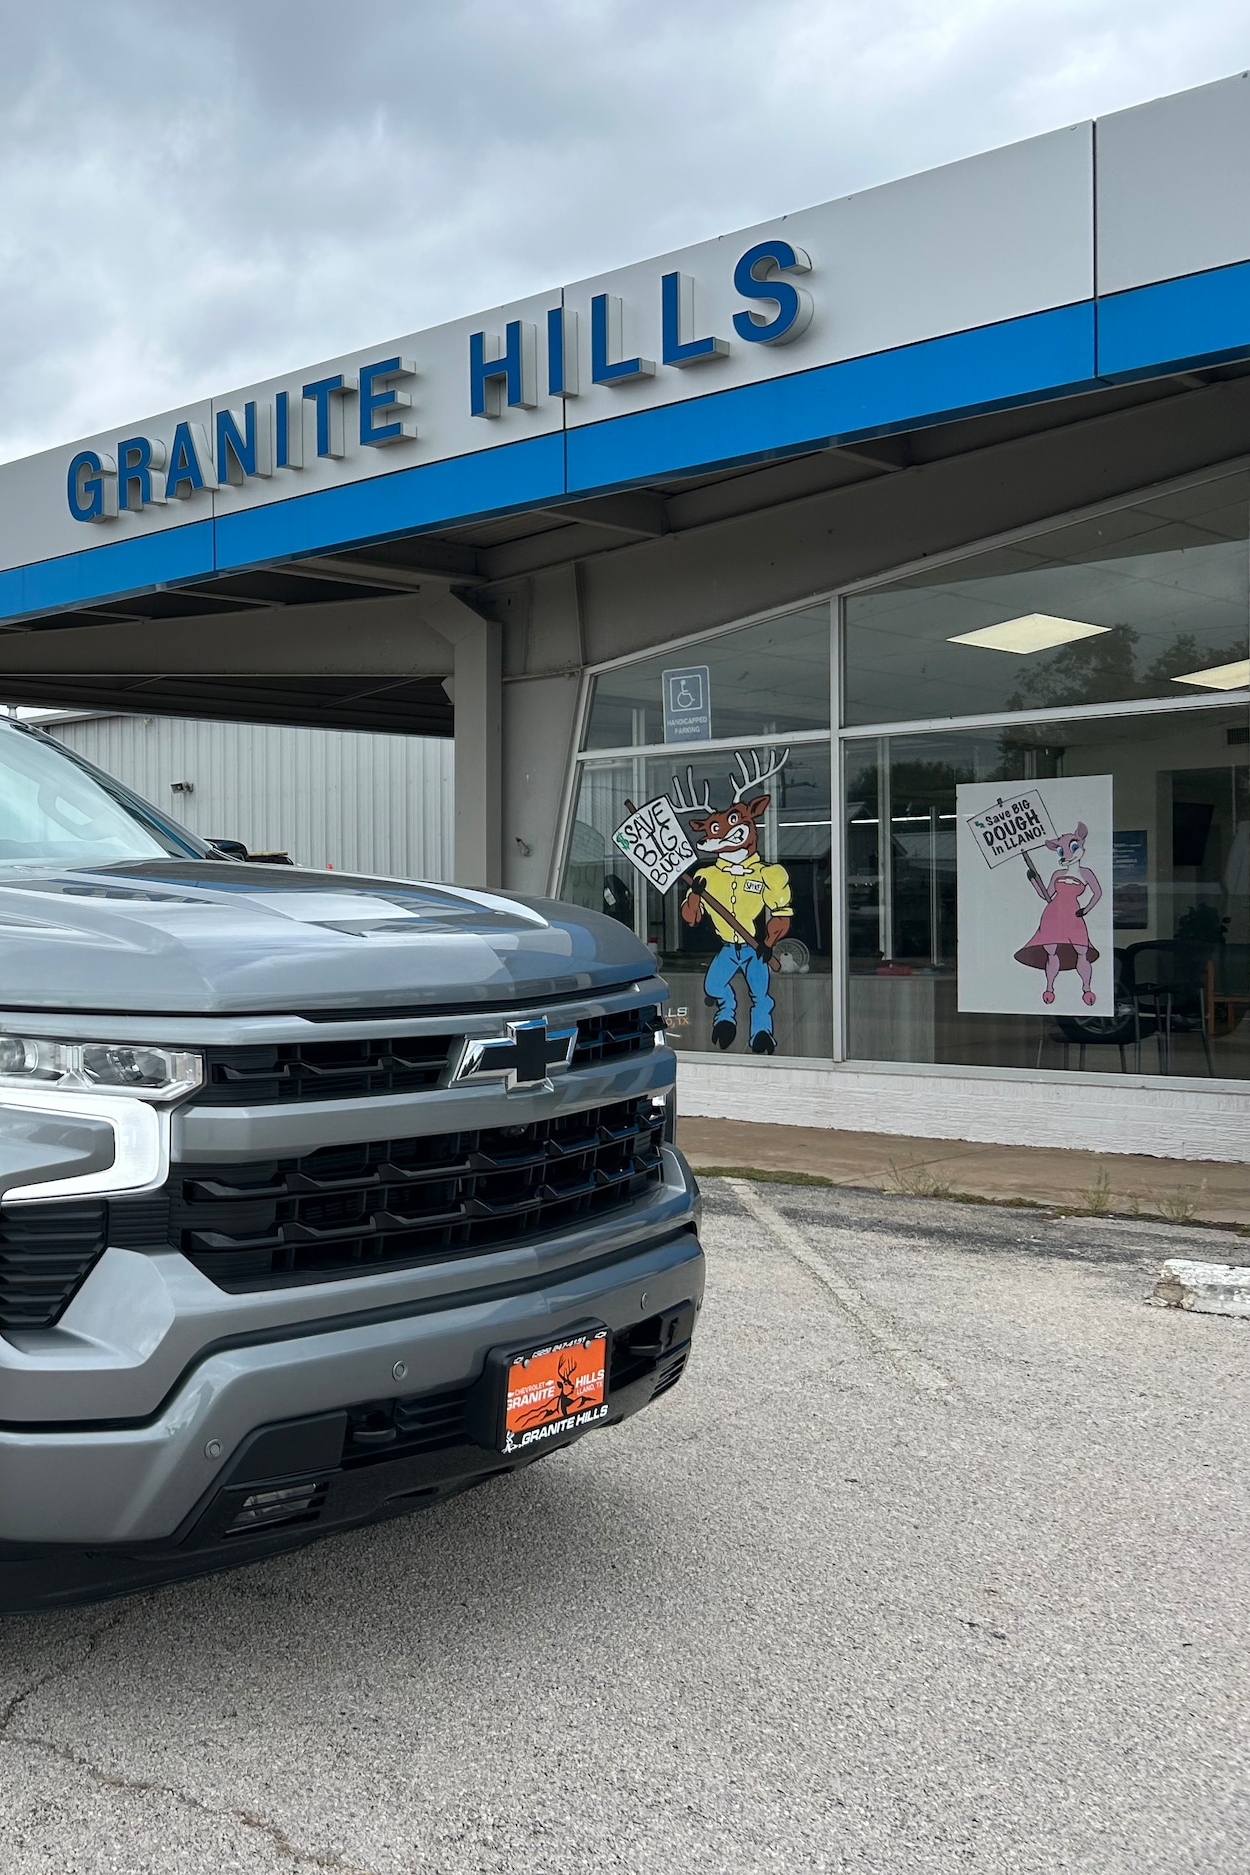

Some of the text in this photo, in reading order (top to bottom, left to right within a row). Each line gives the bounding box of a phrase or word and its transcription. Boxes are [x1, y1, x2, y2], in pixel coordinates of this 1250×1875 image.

[67, 240, 813, 524] GRANITE HILLS
[667, 716, 707, 726] HANDICAPPED
[674, 726, 700, 735] PARKING
[985, 810, 1011, 826] Save
[1011, 799, 1030, 814] BIG
[982, 809, 1041, 847] DOUGH
[991, 824, 1046, 856] in LLANO!
[633, 825, 678, 867] BIG
[650, 841, 694, 886] BUCKS
[676, 1017, 689, 1025] TX
[514, 1381, 546, 1397] CHEVROLET
[575, 1368, 605, 1389] HILLS
[596, 1380, 604, 1389] TX
[522, 1404, 609, 1446] GRANITE HILLS
